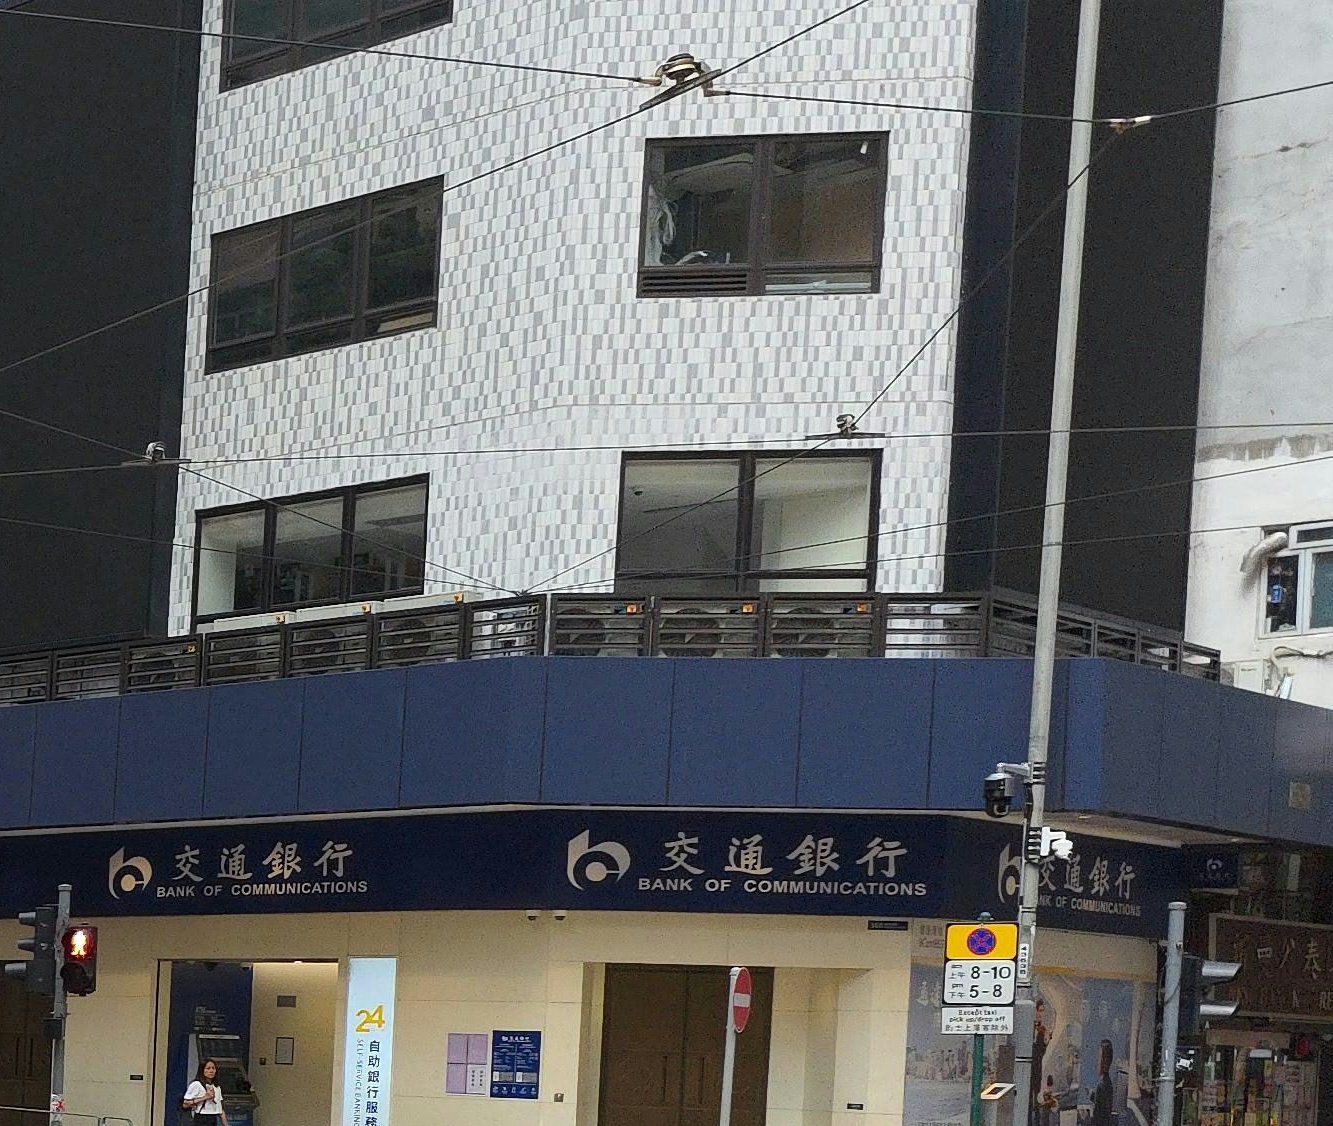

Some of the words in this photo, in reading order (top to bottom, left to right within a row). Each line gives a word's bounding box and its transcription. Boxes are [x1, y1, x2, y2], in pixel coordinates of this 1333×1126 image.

[172, 840, 353, 882] 交通銀行
[659, 831, 908, 878] 交通銀行
[157, 885, 196, 898] BANK
[203, 884, 223, 897] OF
[231, 880, 368, 897] COMMUNICATIONS
[638, 877, 693, 892] BANK
[705, 879, 732, 892] OF
[743, 879, 927, 896] COMMUNICATIONS
[1038, 854, 1136, 900] 交通銀行
[1056, 896, 1067, 907] OF
[1071, 897, 1142, 917] COMMUNICATIONS
[970, 966, 1011, 980] 8-10
[355, 1005, 386, 1033] 24
